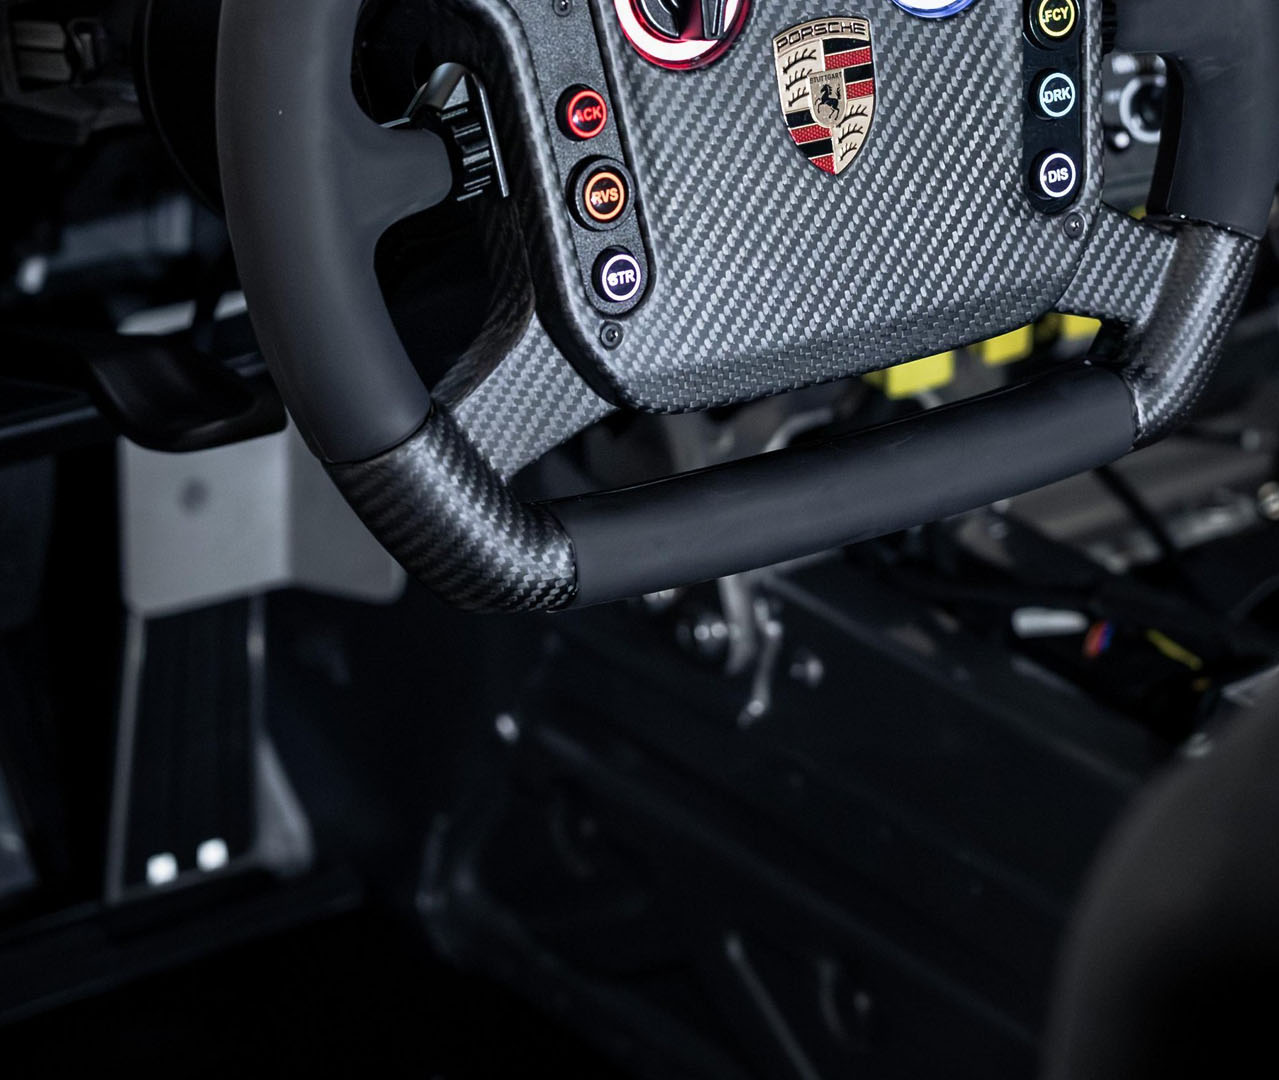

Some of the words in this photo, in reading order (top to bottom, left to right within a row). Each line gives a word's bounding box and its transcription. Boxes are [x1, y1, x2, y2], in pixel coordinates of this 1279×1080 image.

[1044, 6, 1070, 23] FCY
[777, 21, 866, 53] PORSCHE
[809, 71, 843, 84] STUTTGART
[1044, 88, 1071, 104] DRK
[574, 106, 602, 122] ACK
[1047, 167, 1069, 183] DIS
[592, 187, 619, 204] RVS
[607, 269, 635, 286] STR
